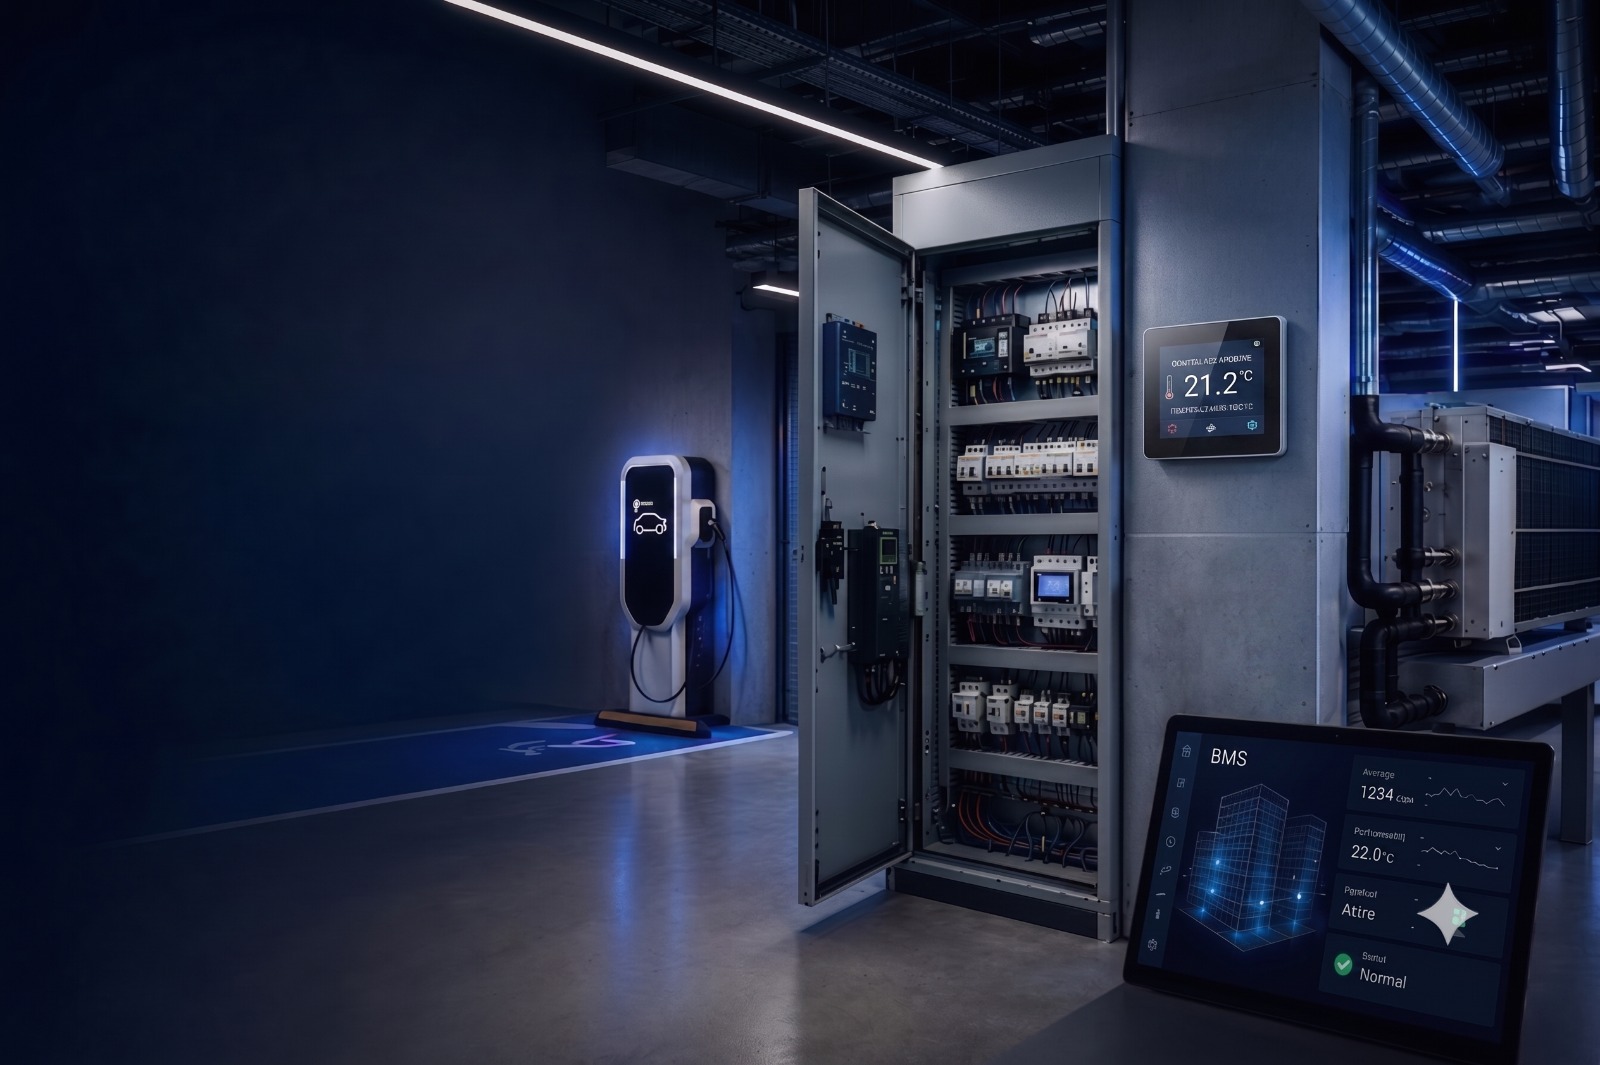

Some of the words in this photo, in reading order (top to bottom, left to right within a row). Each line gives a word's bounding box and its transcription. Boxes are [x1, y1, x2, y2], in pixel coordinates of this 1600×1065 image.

[1210, 748, 1248, 767] BMS
[1362, 768, 1395, 780] Average
[1361, 785, 1394, 801] 1234
[1341, 903, 1376, 921] Atire
[1359, 967, 1407, 989] Normal
